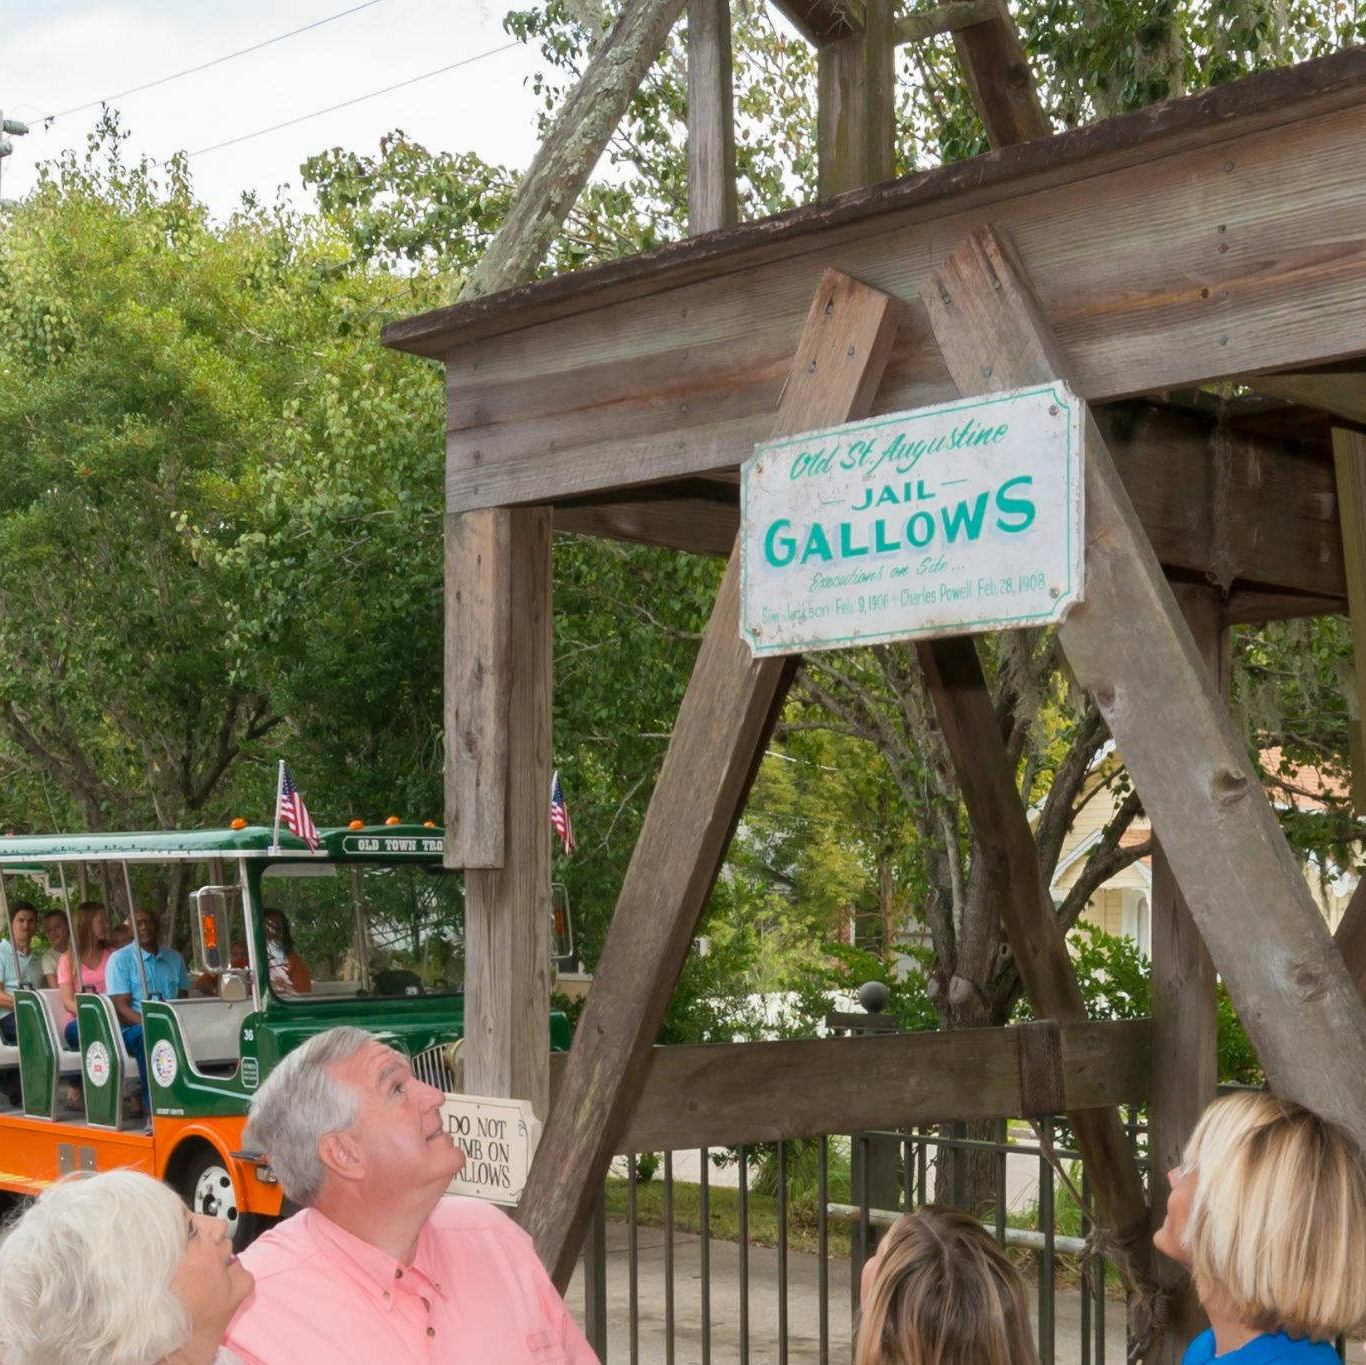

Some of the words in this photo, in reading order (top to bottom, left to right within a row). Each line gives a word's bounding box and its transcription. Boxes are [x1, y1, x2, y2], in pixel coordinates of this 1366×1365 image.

[789, 446, 836, 481] Old
[839, 439, 875, 470] St.
[866, 418, 1009, 475] Augustine
[851, 480, 936, 511] JAIL
[764, 475, 1036, 568] GALLOWS
[808, 565, 884, 592] Executions
[890, 565, 909, 578] on
[900, 588, 936, 608] Charles
[940, 580, 972, 602] Powell
[1019, 571, 1046, 593] 1908
[358, 839, 379, 851] OLD
[385, 839, 417, 851] TOWN
[422, 840, 443, 851] TRO
[448, 1114, 470, 1136] DO
[477, 1117, 506, 1139] NOT
[488, 1141, 509, 1163] ON
